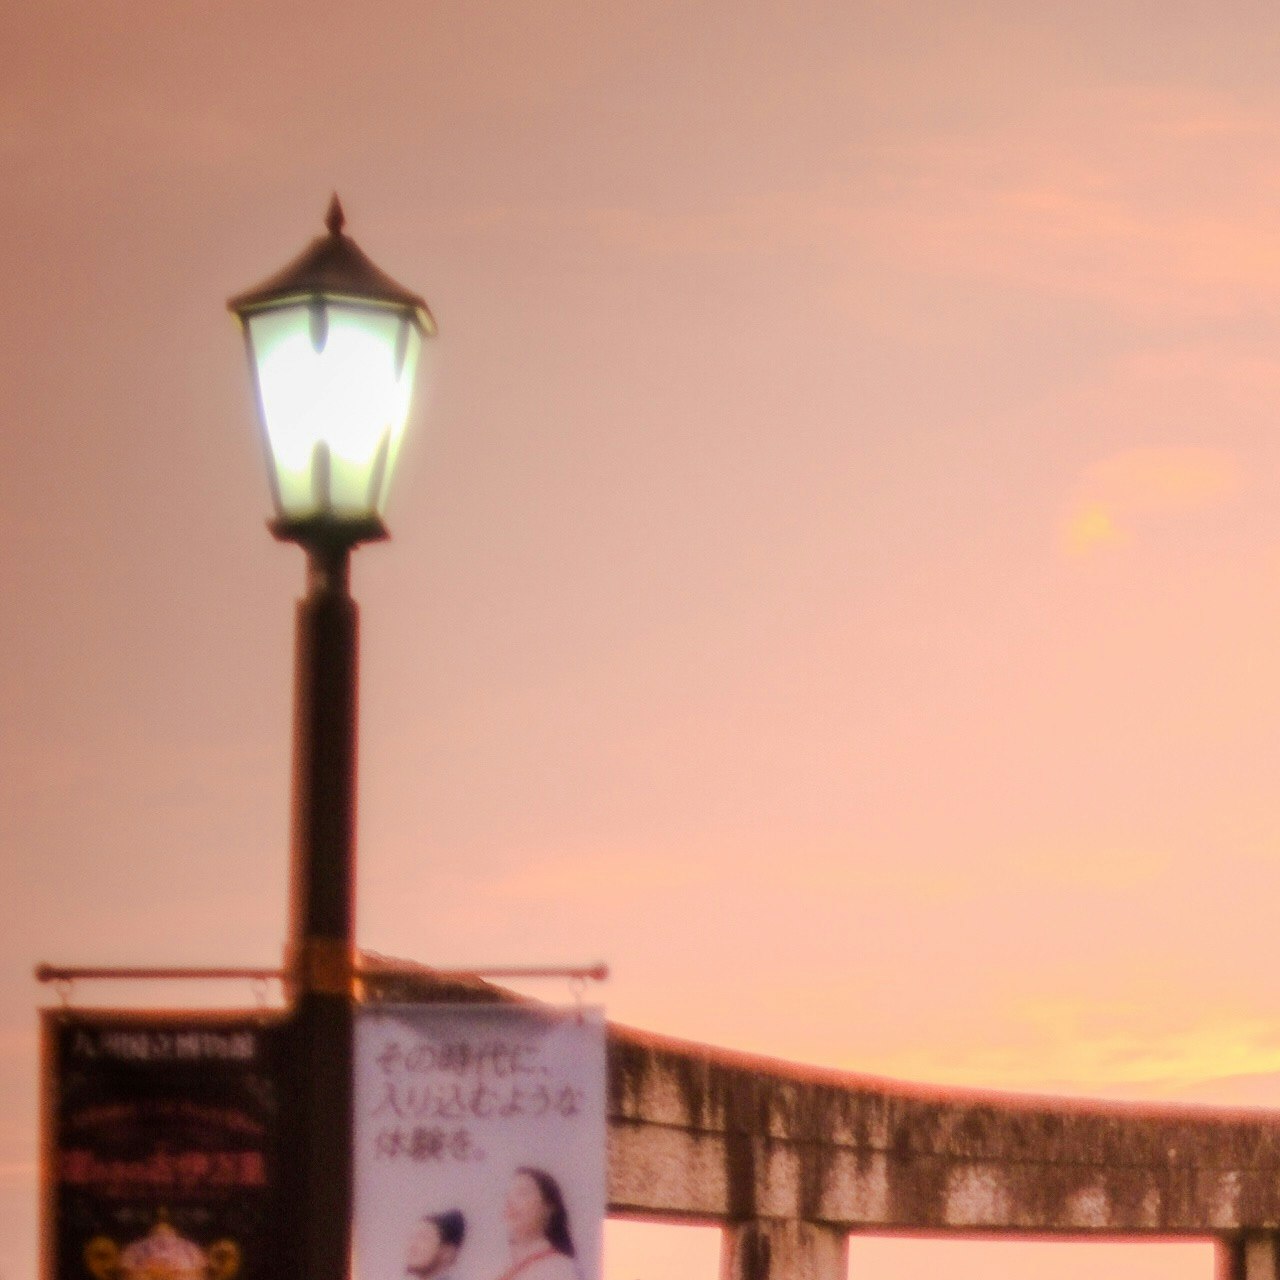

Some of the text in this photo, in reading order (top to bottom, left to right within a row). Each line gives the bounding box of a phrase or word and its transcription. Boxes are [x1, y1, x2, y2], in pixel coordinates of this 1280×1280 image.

[371, 1082, 586, 1119] 入り込むような
[374, 1127, 488, 1162] 体験を。
